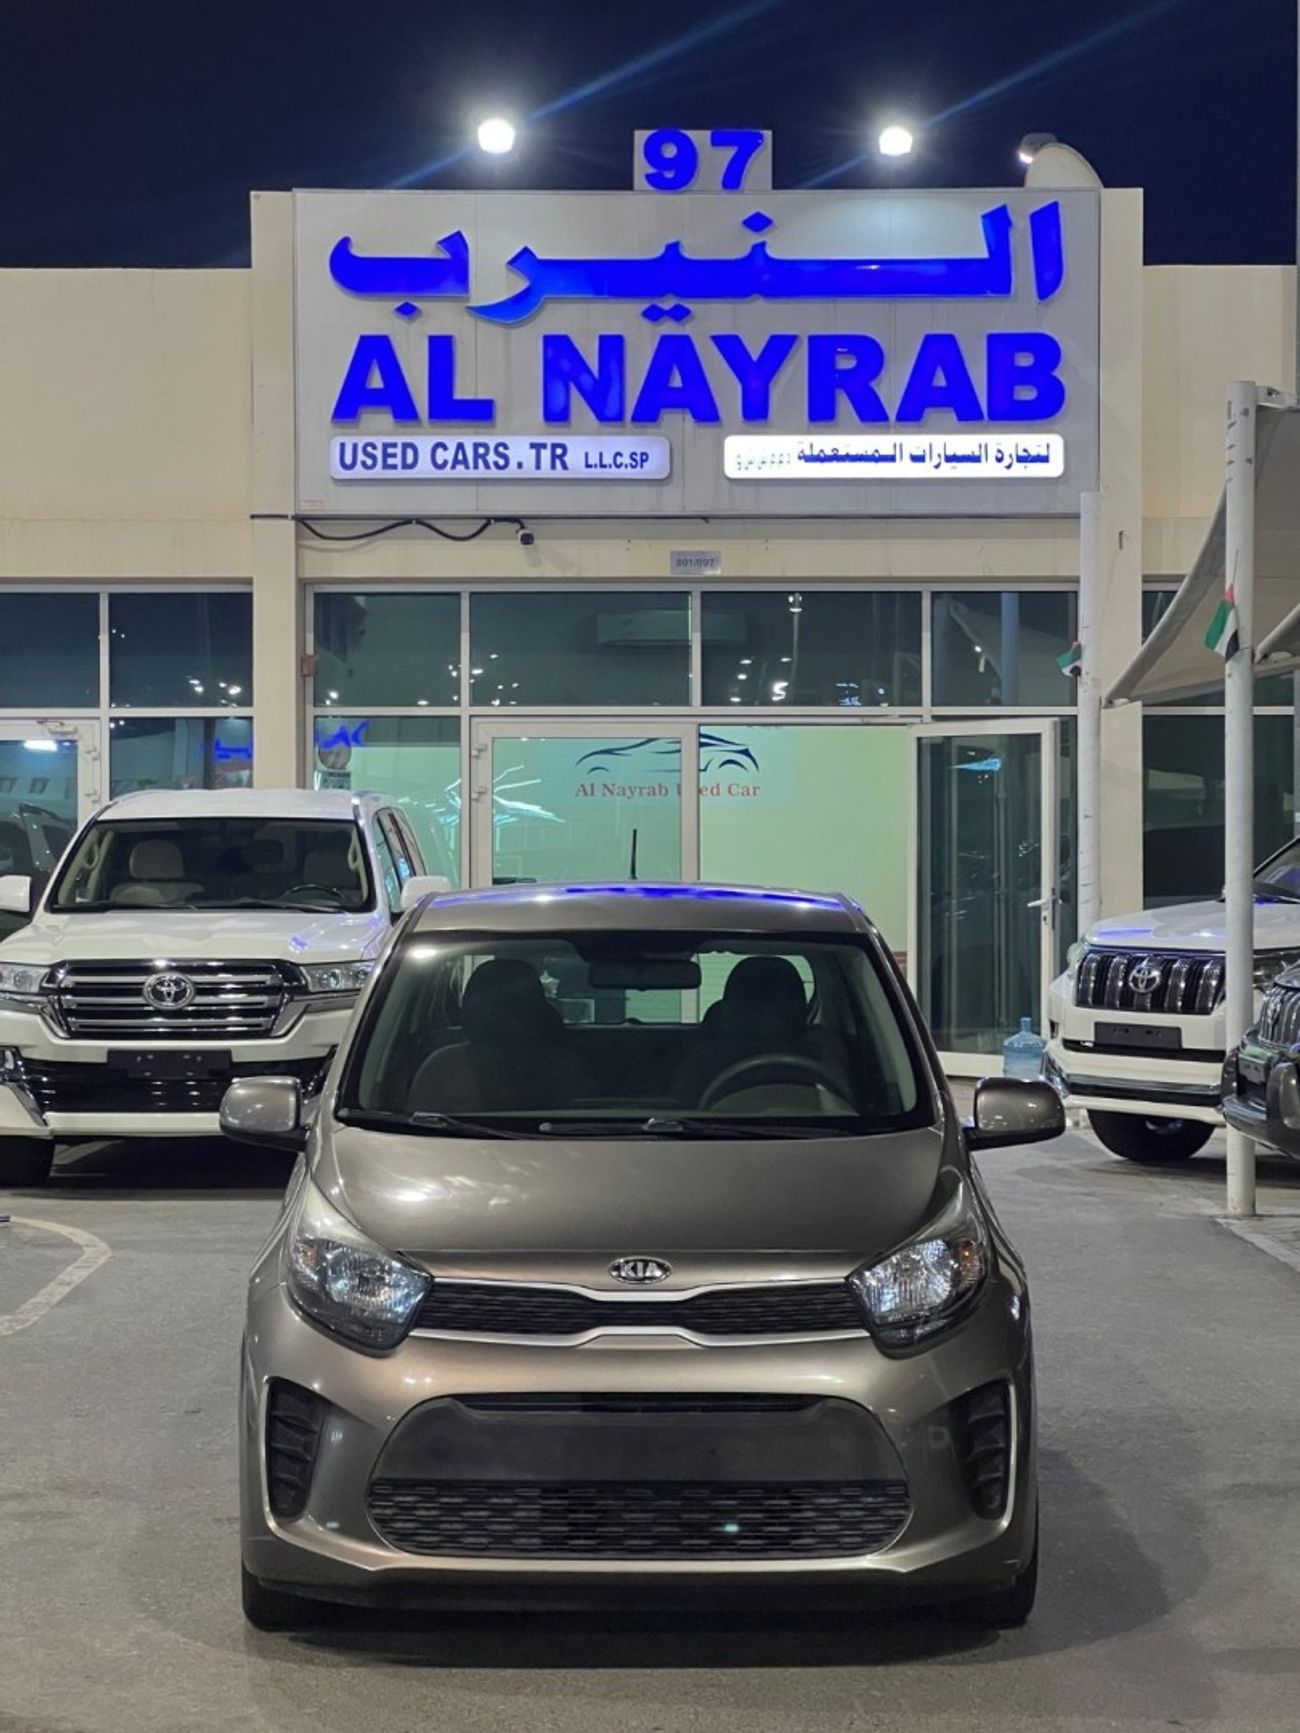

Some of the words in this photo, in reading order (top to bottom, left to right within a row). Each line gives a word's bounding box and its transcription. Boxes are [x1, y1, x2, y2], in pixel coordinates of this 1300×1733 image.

[643, 128, 764, 193] 97
[329, 201, 1065, 325] النيرب
[331, 333, 495, 424] AL
[542, 332, 1067, 424] NAYRAB
[338, 442, 419, 471] USED
[584, 451, 650, 469] L.L.C.SP
[797, 441, 904, 465] المستعملة
[908, 442, 989, 470] السيارات
[994, 442, 1051, 469] لتجارة
[575, 783, 596, 797] Al
[601, 783, 669, 799] Nayrab
[727, 784, 761, 797] Car
[620, 1261, 663, 1277] KIA
